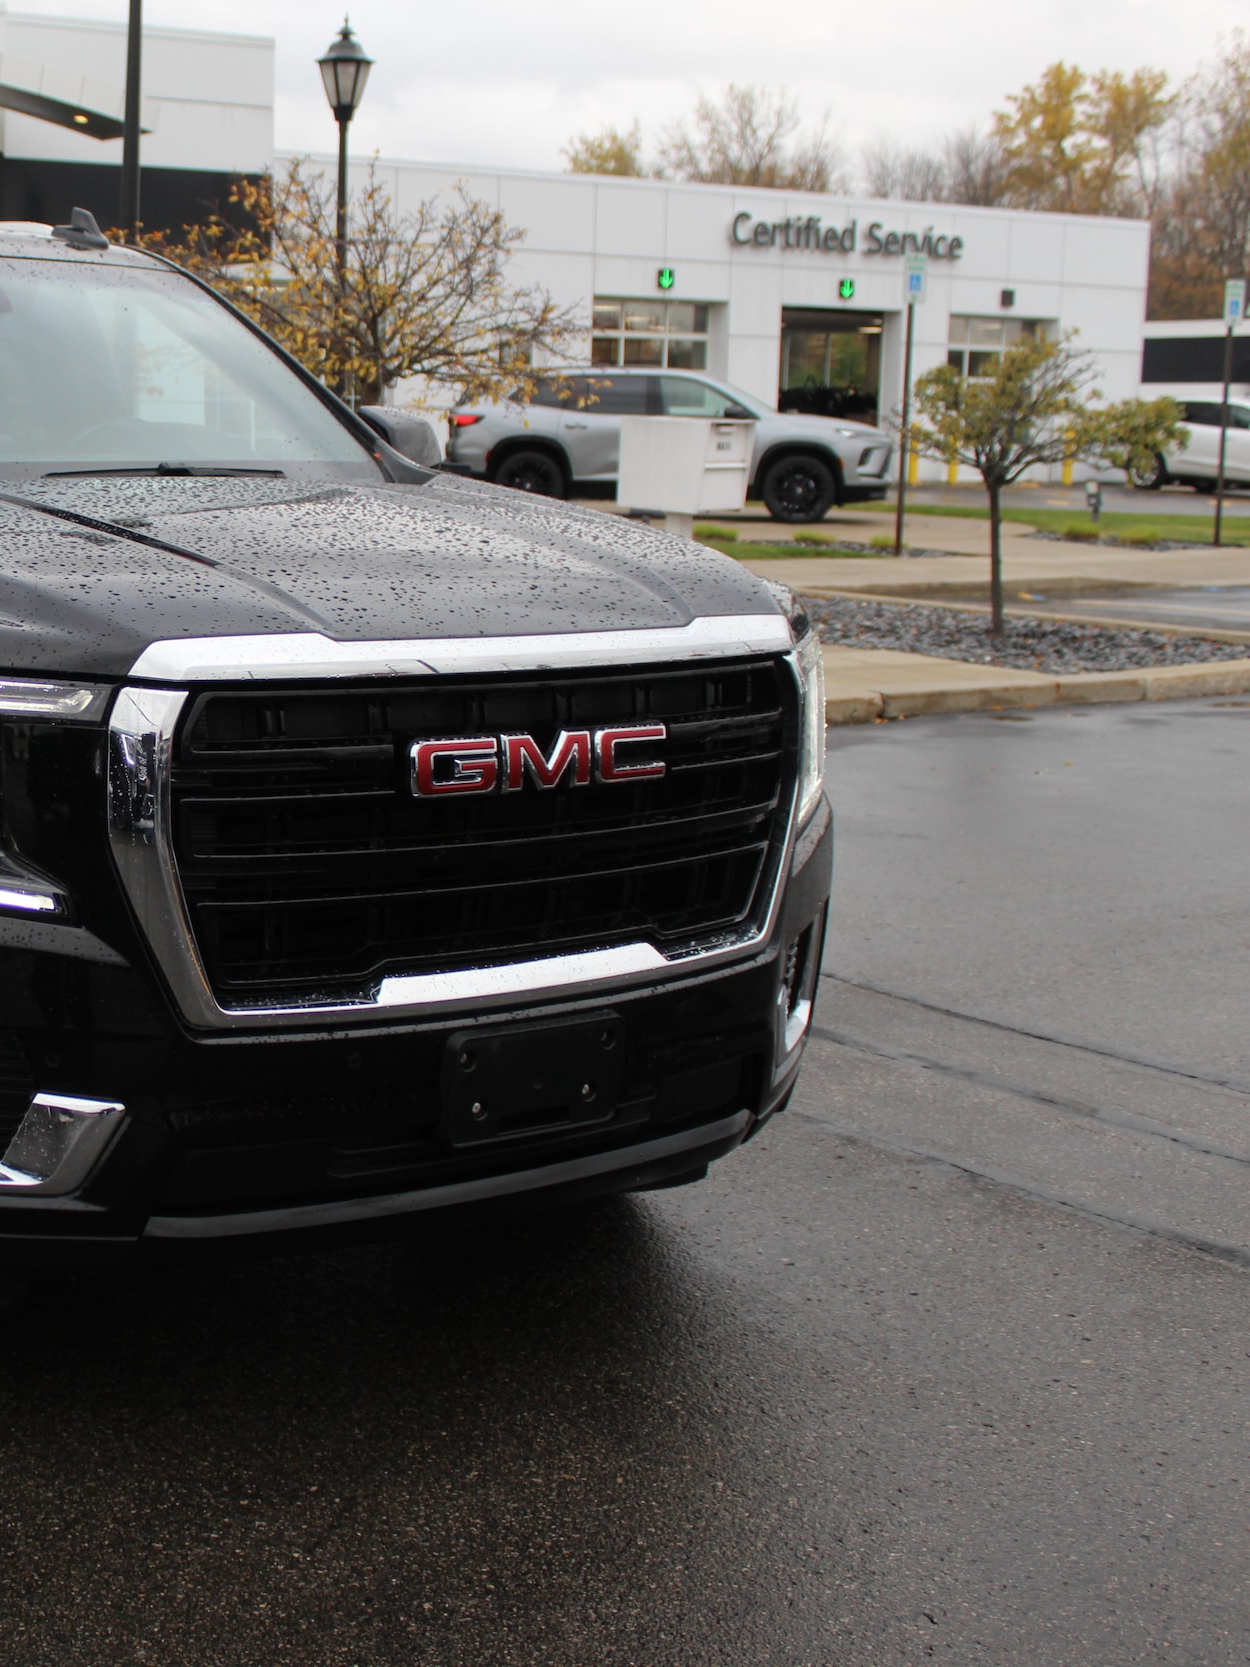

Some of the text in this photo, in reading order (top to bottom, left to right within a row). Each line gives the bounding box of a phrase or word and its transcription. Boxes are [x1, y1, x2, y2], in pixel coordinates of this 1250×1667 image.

[731, 211, 964, 260] Certified Service
[409, 722, 667, 797] GMC
